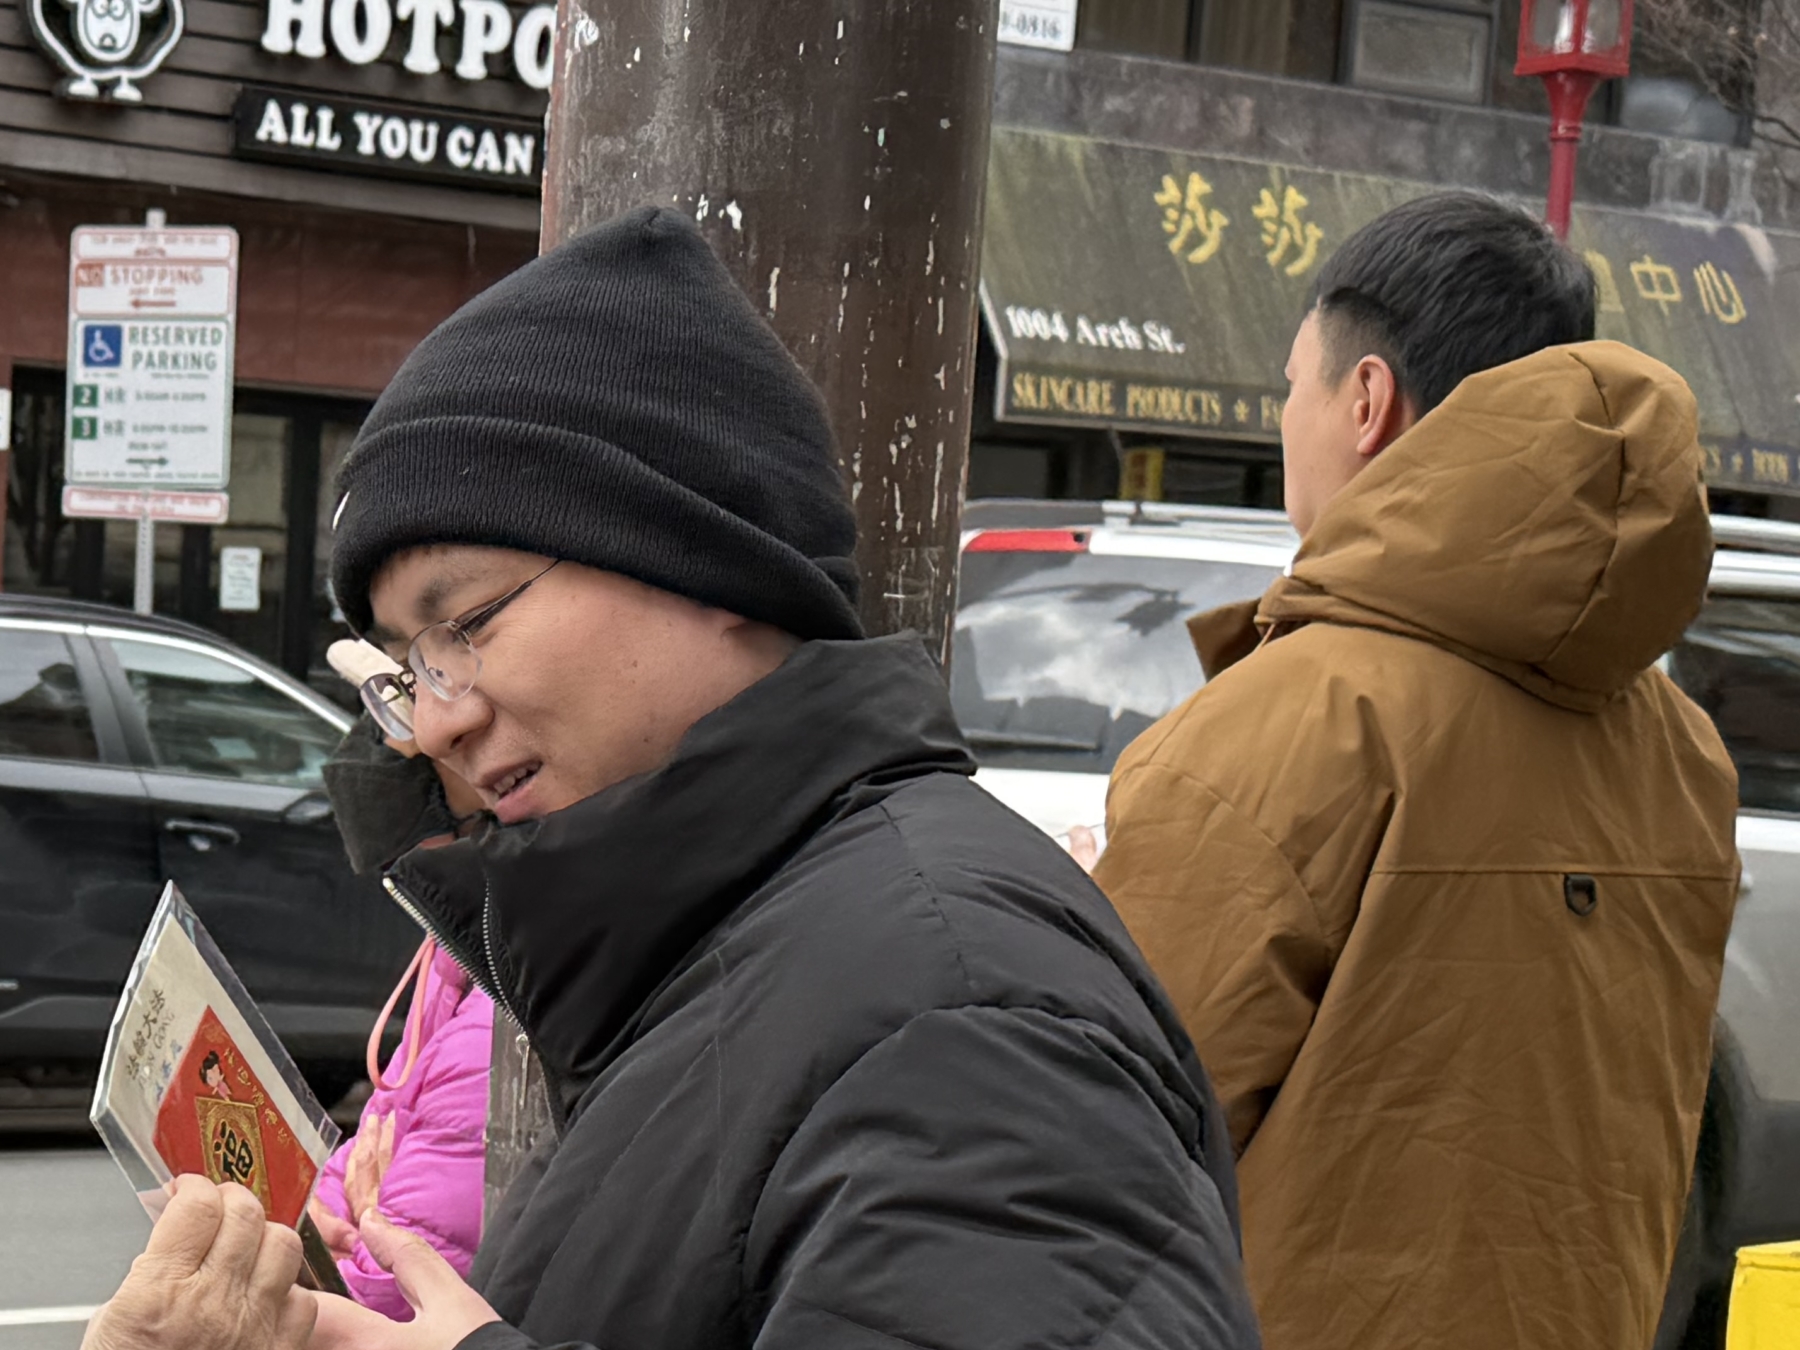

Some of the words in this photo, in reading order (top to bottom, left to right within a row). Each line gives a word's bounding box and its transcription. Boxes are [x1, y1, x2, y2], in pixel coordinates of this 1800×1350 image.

[255, 99, 342, 150] ALL
[353, 112, 439, 163] YOU
[446, 126, 535, 176] CAN
[110, 266, 204, 286] STOPPING
[128, 326, 224, 347] RESERVED
[1006, 305, 1070, 342] 1004
[1076, 314, 1143, 350] Arch
[1143, 320, 1186, 354] St.
[131, 351, 218, 371] PARKING
[1012, 372, 1116, 415] SKINCARE
[1126, 383, 1223, 425] PRODUCTS
